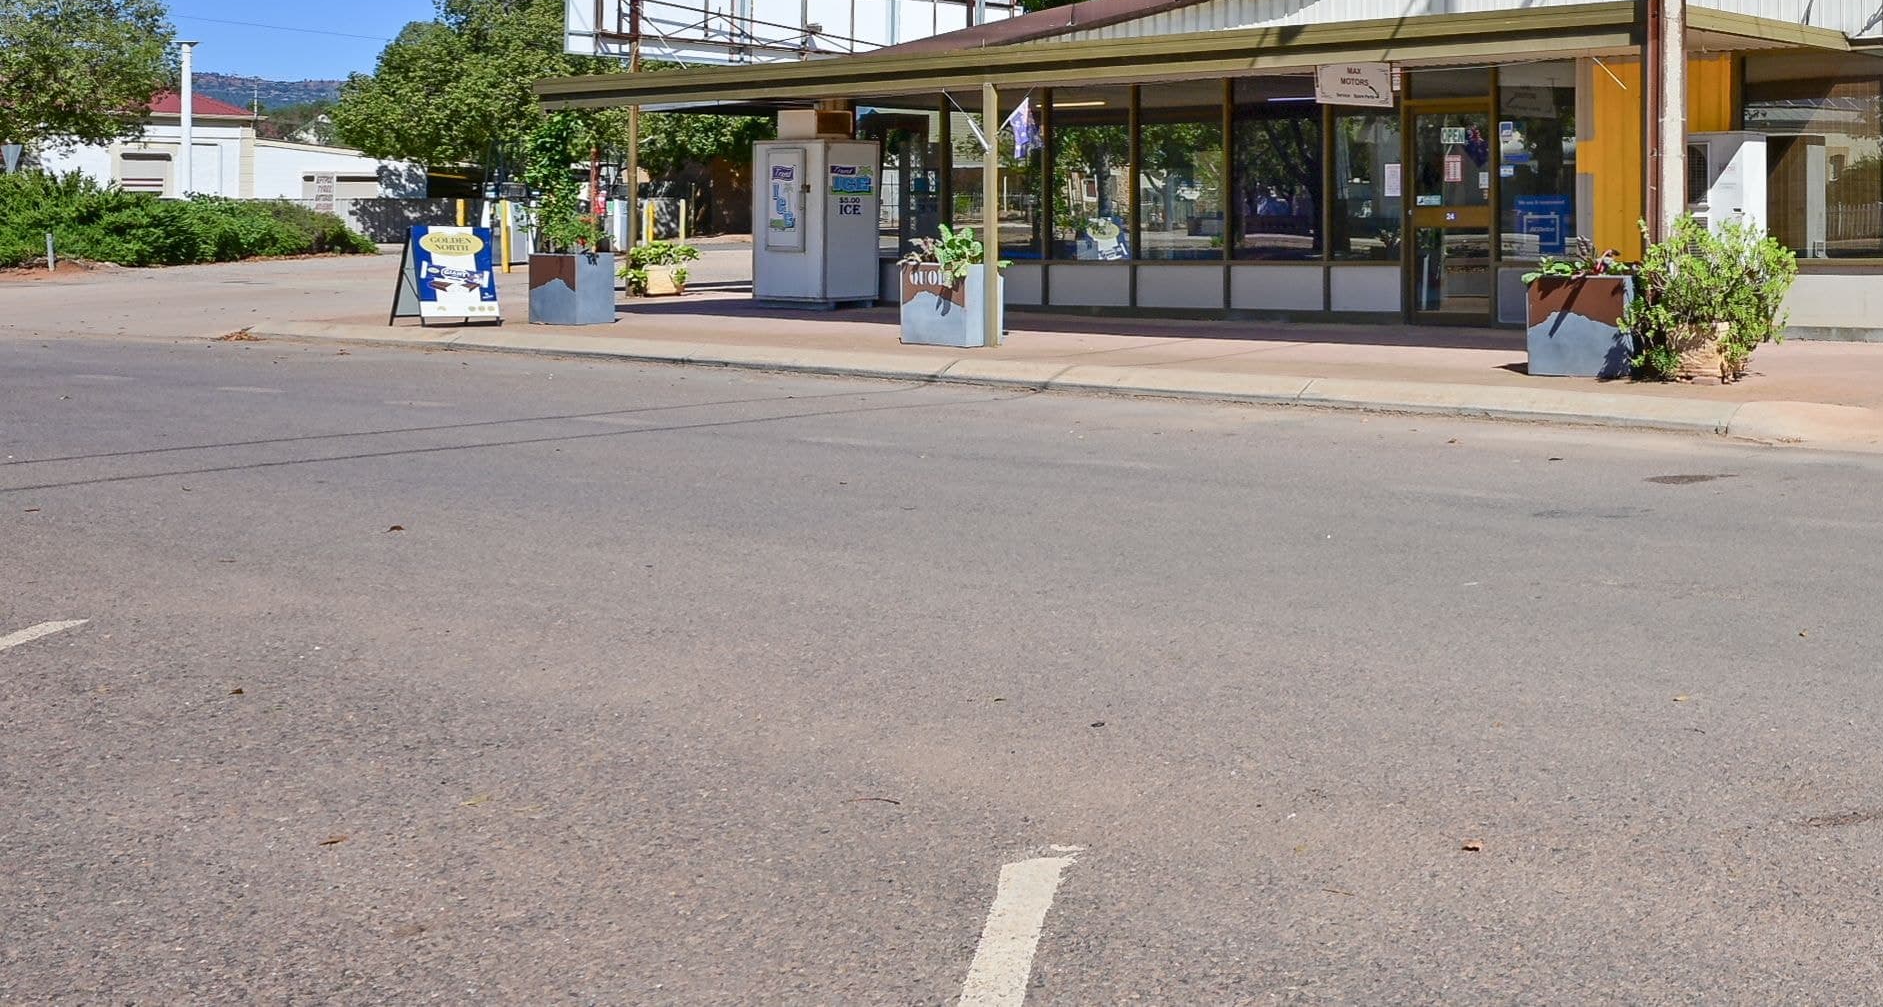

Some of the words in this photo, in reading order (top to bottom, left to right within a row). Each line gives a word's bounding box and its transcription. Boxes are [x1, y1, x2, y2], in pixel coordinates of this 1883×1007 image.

[1347, 67, 1361, 75] MAX
[1340, 77, 1369, 87] MOTORS
[1441, 128, 1464, 142] OPEN
[840, 205, 861, 215] ICE
